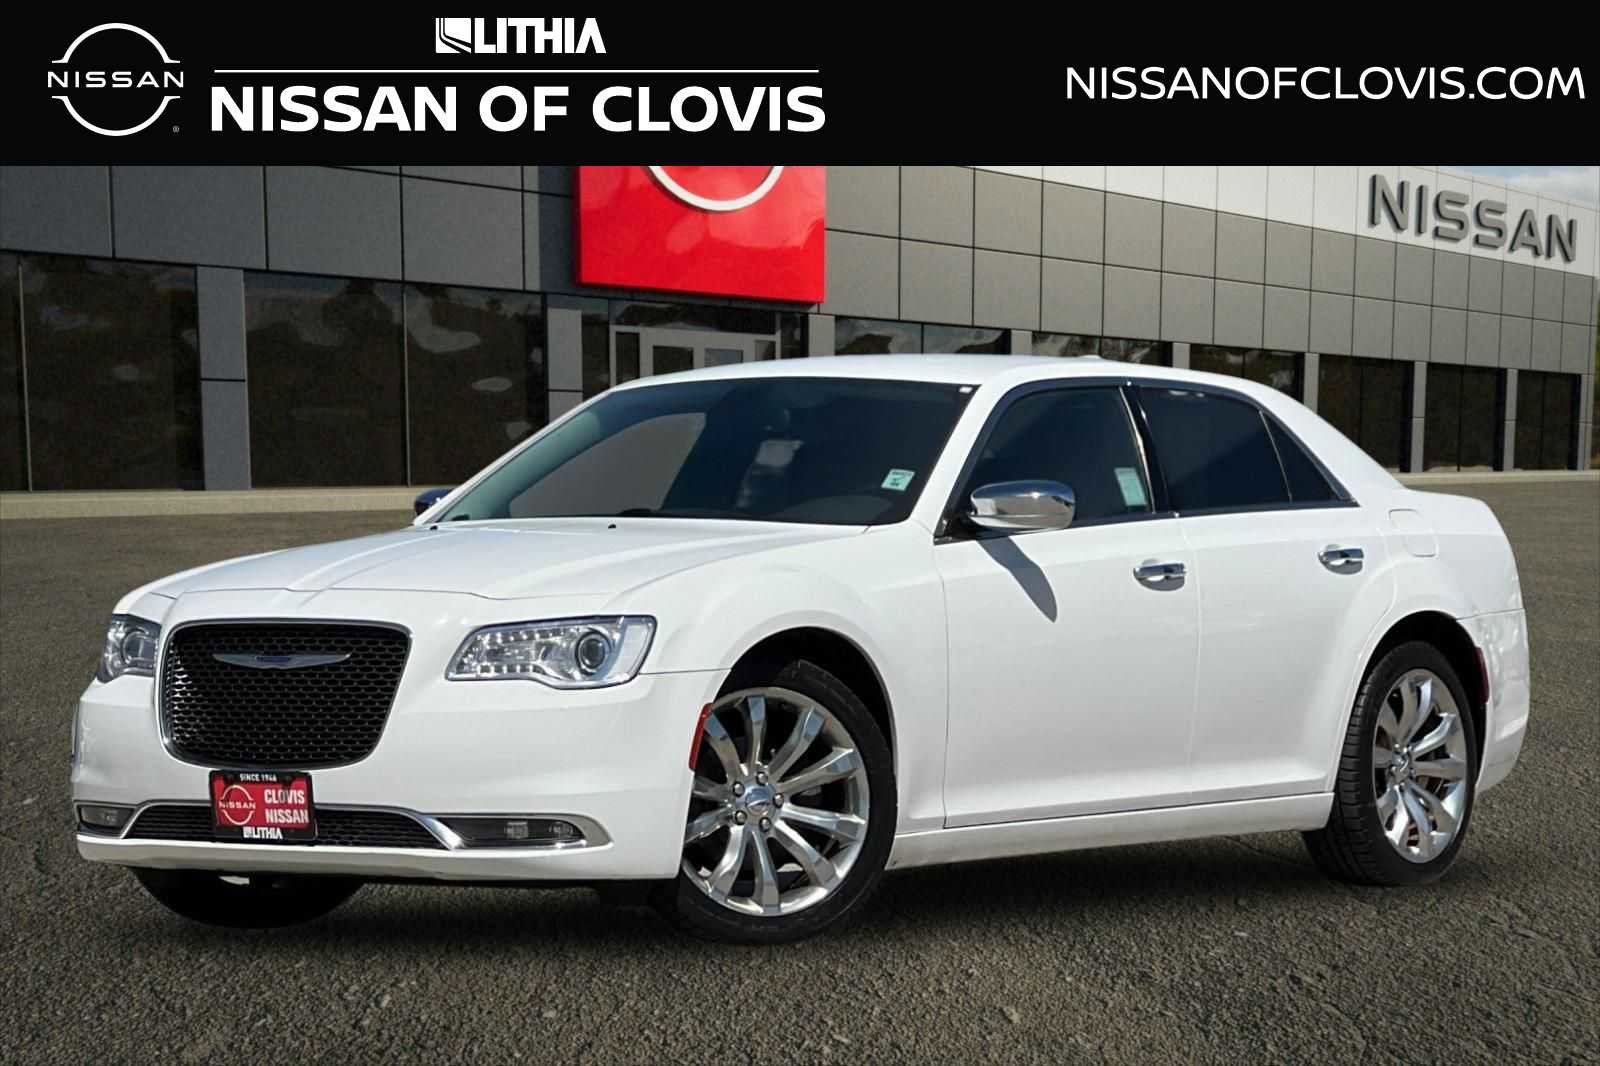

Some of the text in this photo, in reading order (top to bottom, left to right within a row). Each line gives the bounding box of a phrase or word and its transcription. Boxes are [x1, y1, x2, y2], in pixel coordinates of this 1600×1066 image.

[1369, 174, 1577, 263] NISSAN
[240, 773, 260, 782] SINCE
[264, 789, 305, 804] CLOVIS
[218, 800, 256, 809] NISSAN
[265, 809, 309, 823] NISSAN
[252, 826, 283, 839] LITHIA
